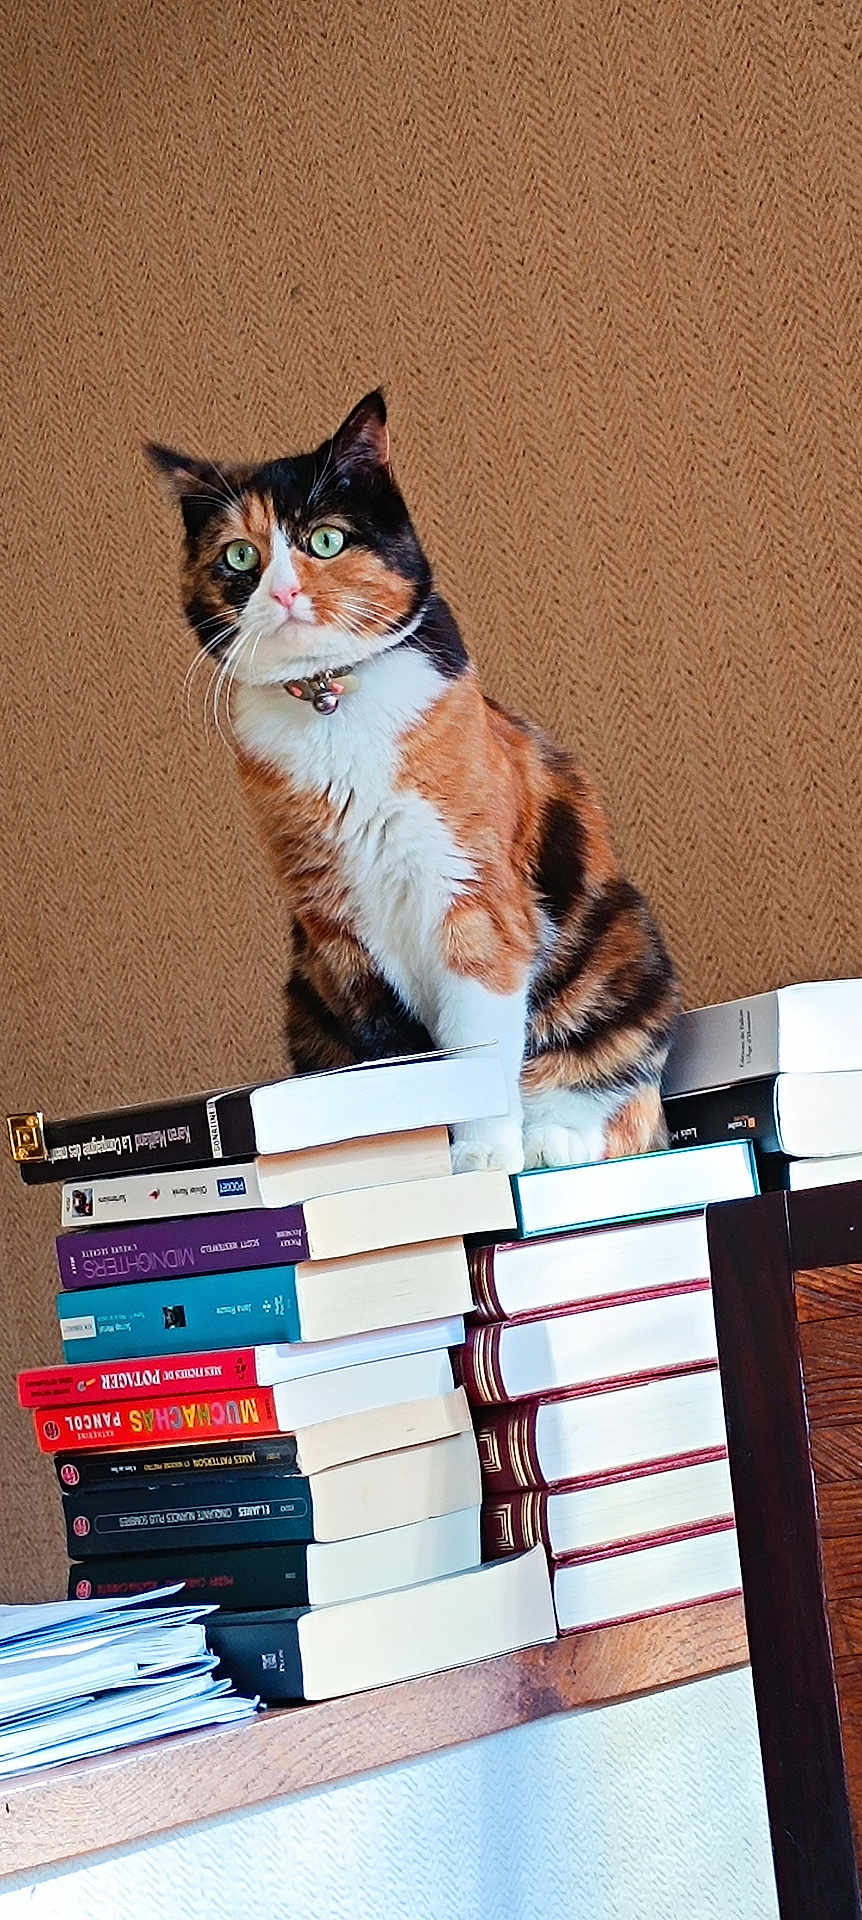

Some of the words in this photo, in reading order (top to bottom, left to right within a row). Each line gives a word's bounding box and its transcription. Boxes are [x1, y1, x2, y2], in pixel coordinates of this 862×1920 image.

[121, 1134, 133, 1154] La
[166, 1125, 191, 1144] Karen
[68, 1143, 81, 1162] des
[82, 1135, 122, 1160] Compagnie
[219, 1179, 244, 1193] POCKET
[82, 1247, 195, 1279] MIDNIGHTERS
[100, 1369, 161, 1390] POTAGER
[204, 1365, 223, 1377] MES
[64, 1411, 122, 1432] PANCOL
[128, 1398, 260, 1433] MUCHACHAS
[192, 1455, 232, 1469] PATTERSON
[233, 1450, 256, 1465] JAMES
